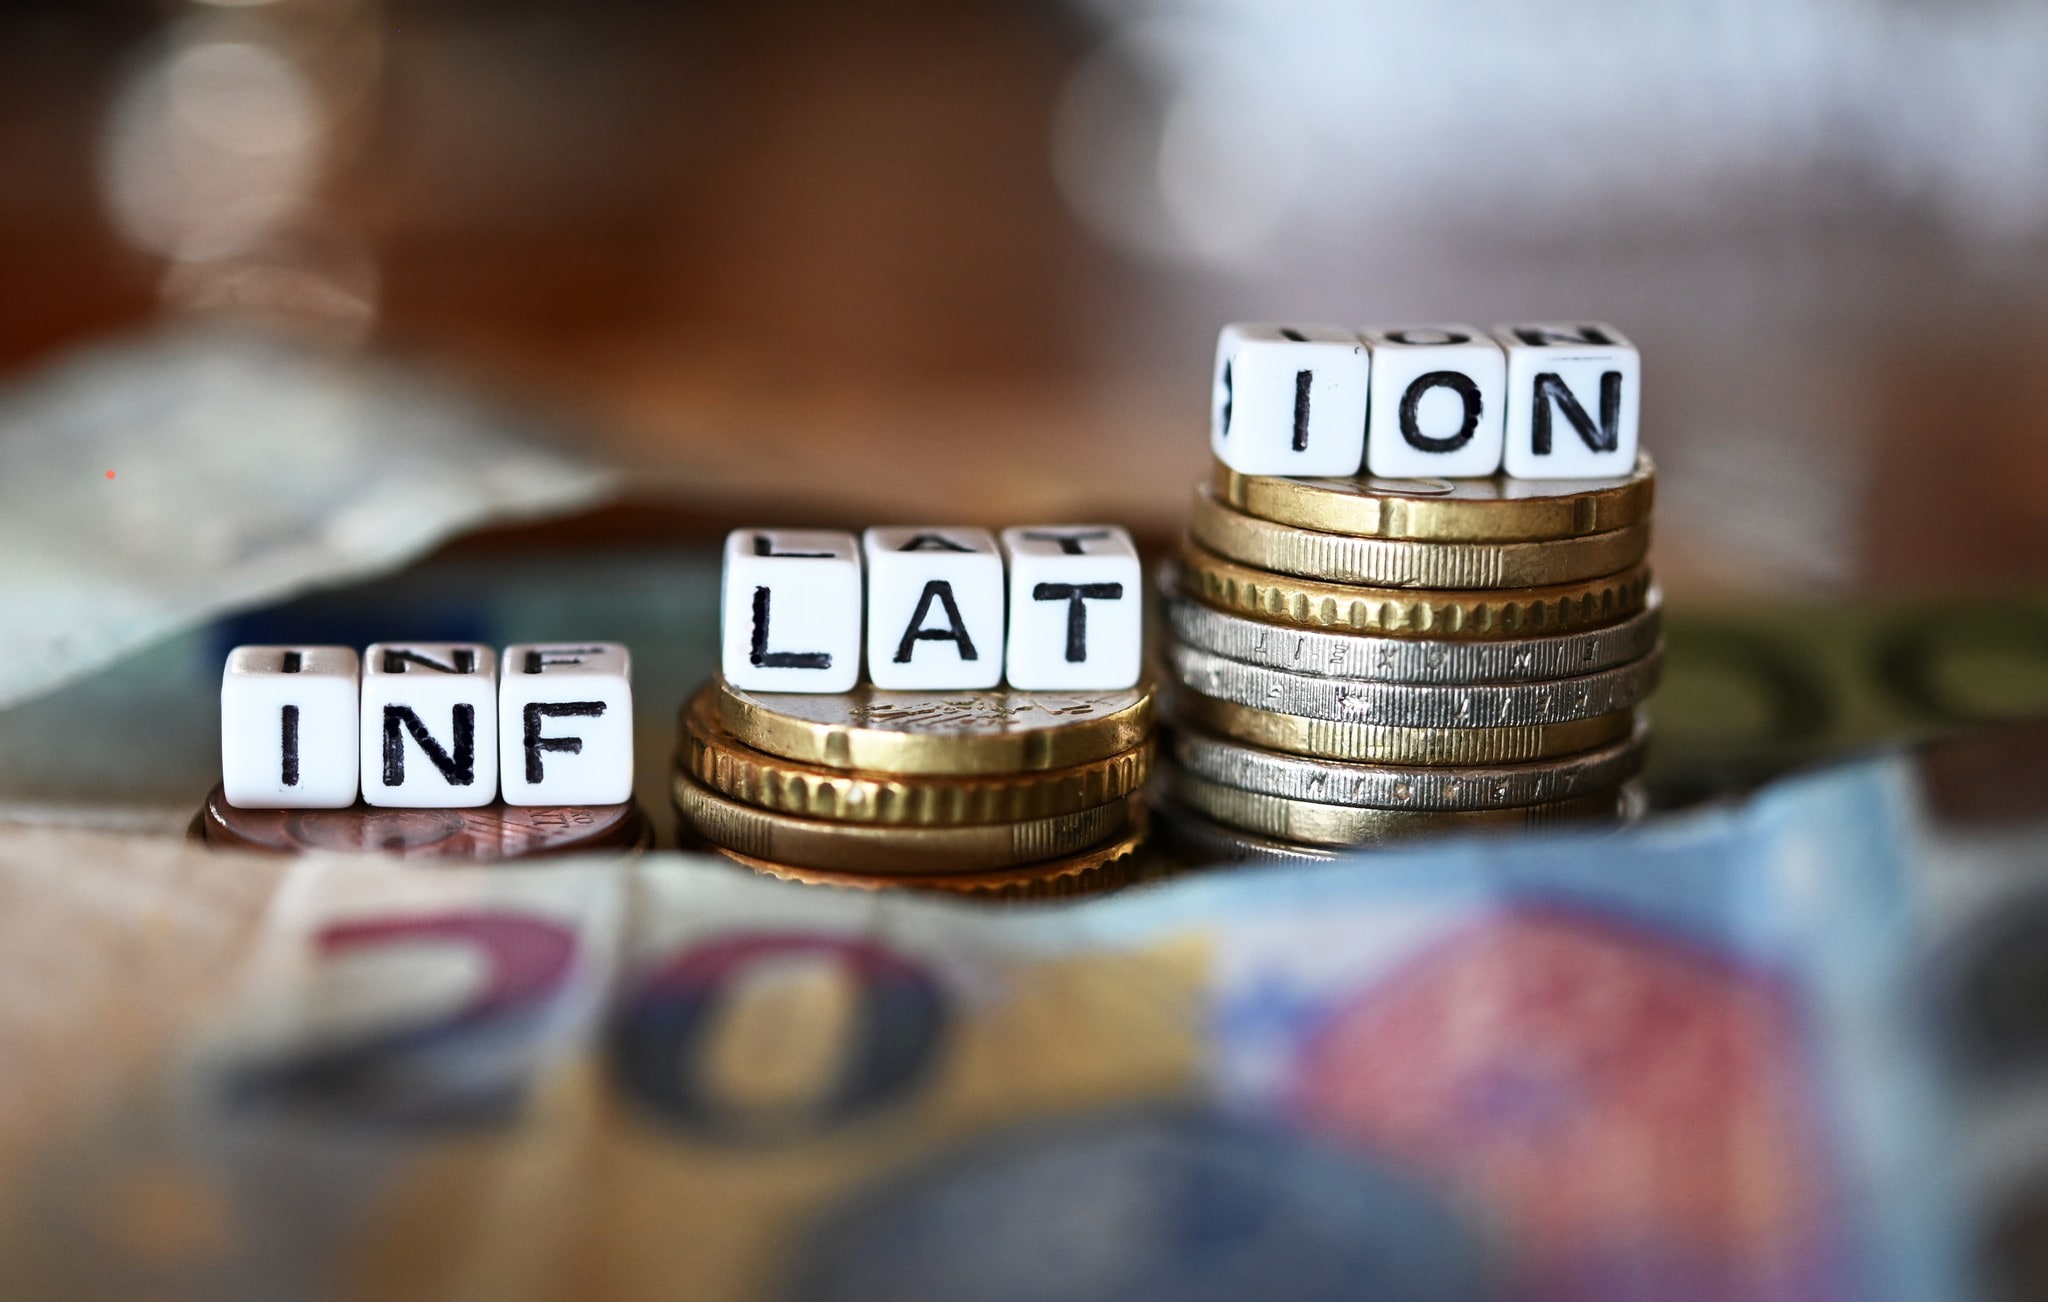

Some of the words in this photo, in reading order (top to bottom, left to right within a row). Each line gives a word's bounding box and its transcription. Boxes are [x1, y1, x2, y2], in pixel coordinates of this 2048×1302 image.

[1291, 369, 1623, 456] ION
[749, 579, 1124, 669] LAT
[280, 700, 608, 787] INF
